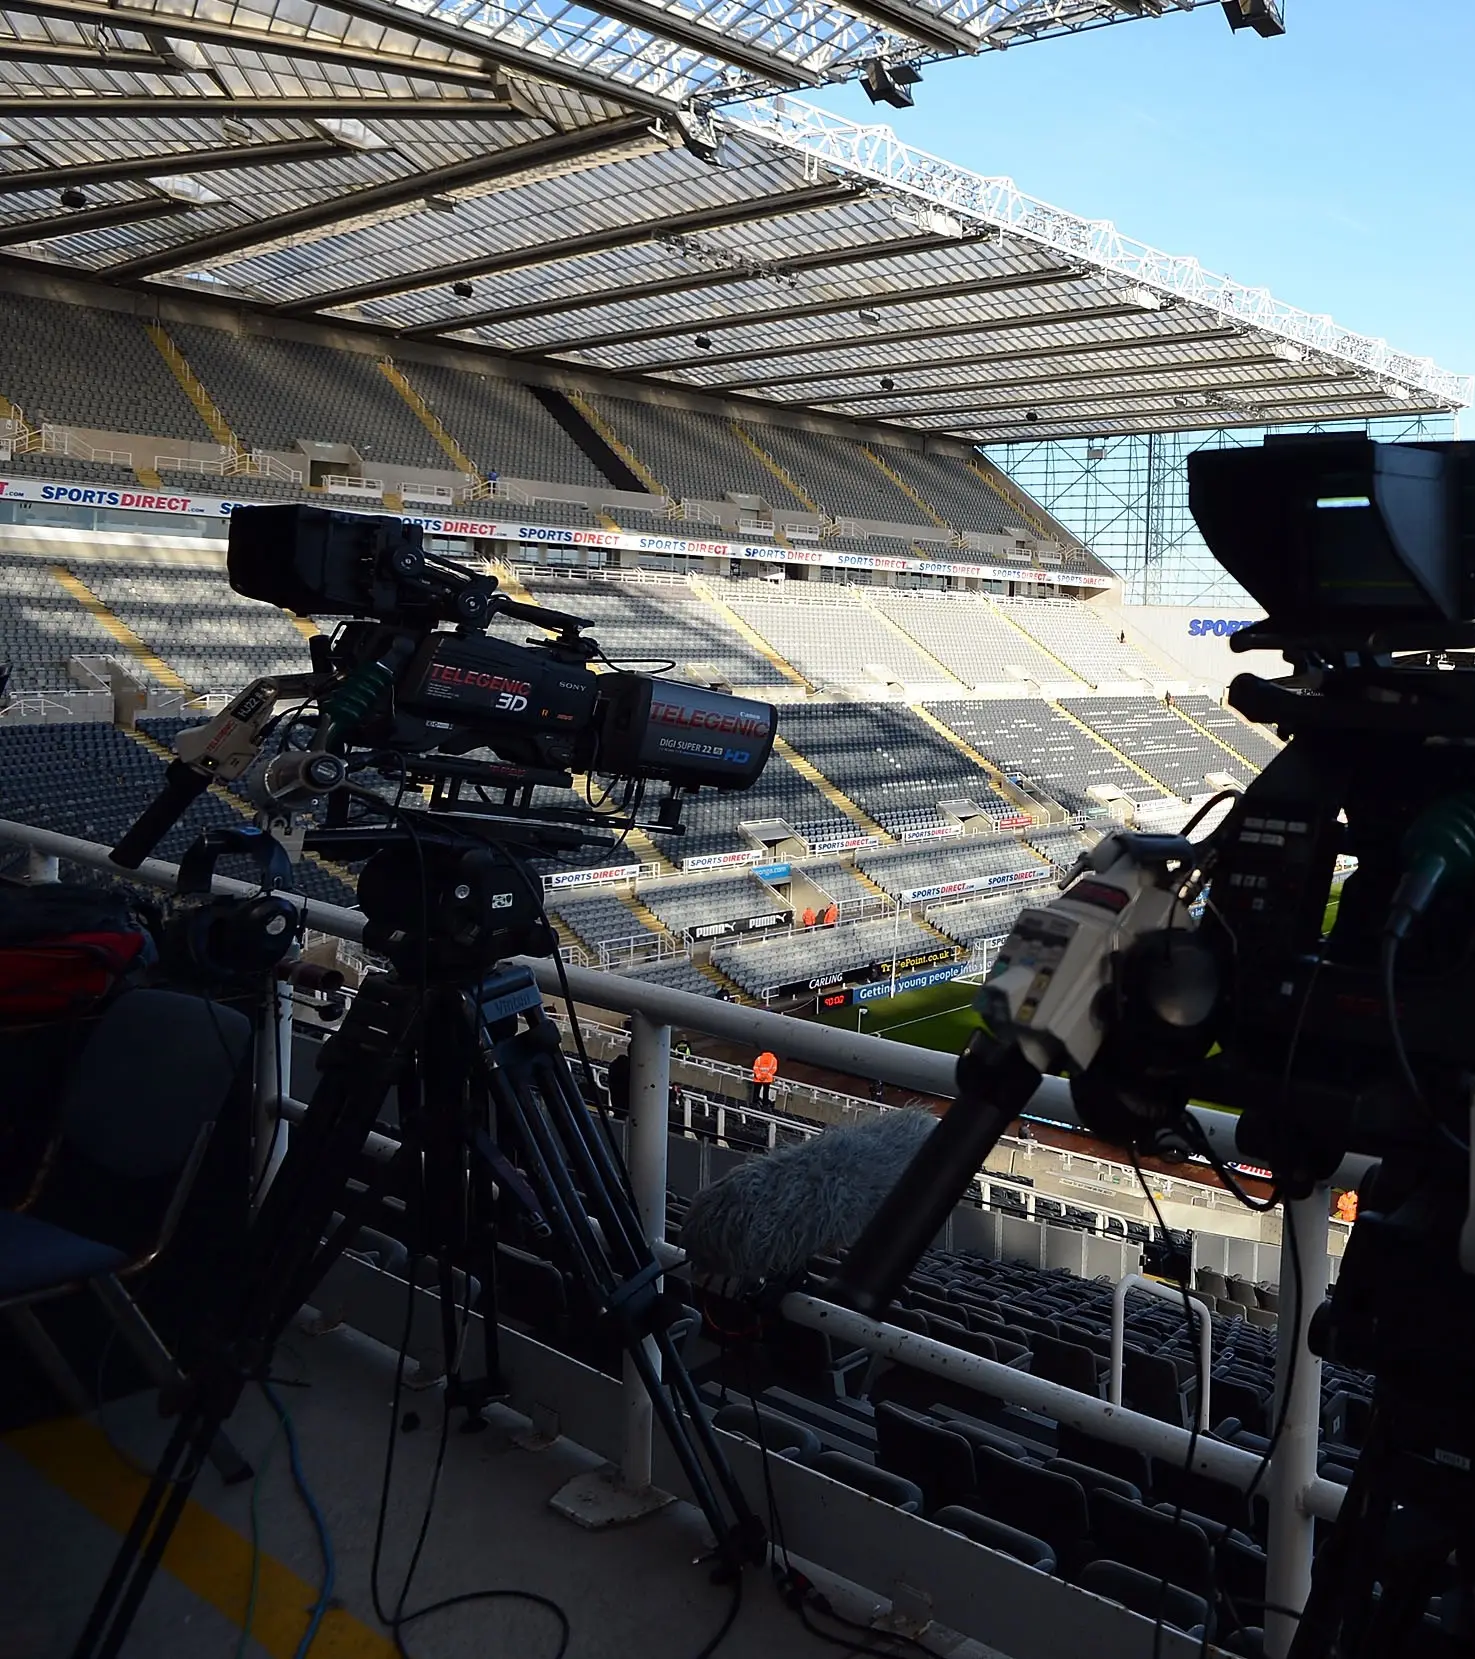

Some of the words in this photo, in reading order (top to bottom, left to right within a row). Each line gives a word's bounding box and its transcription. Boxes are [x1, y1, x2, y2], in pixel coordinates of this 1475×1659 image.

[431, 663, 532, 696] TELEGENIC
[559, 680, 587, 692] SONY
[495, 692, 528, 711] 3D
[651, 701, 770, 738] TELEGENIC
[808, 972, 843, 989] CARLING
[899, 976, 927, 993] young
[929, 968, 959, 986] people
